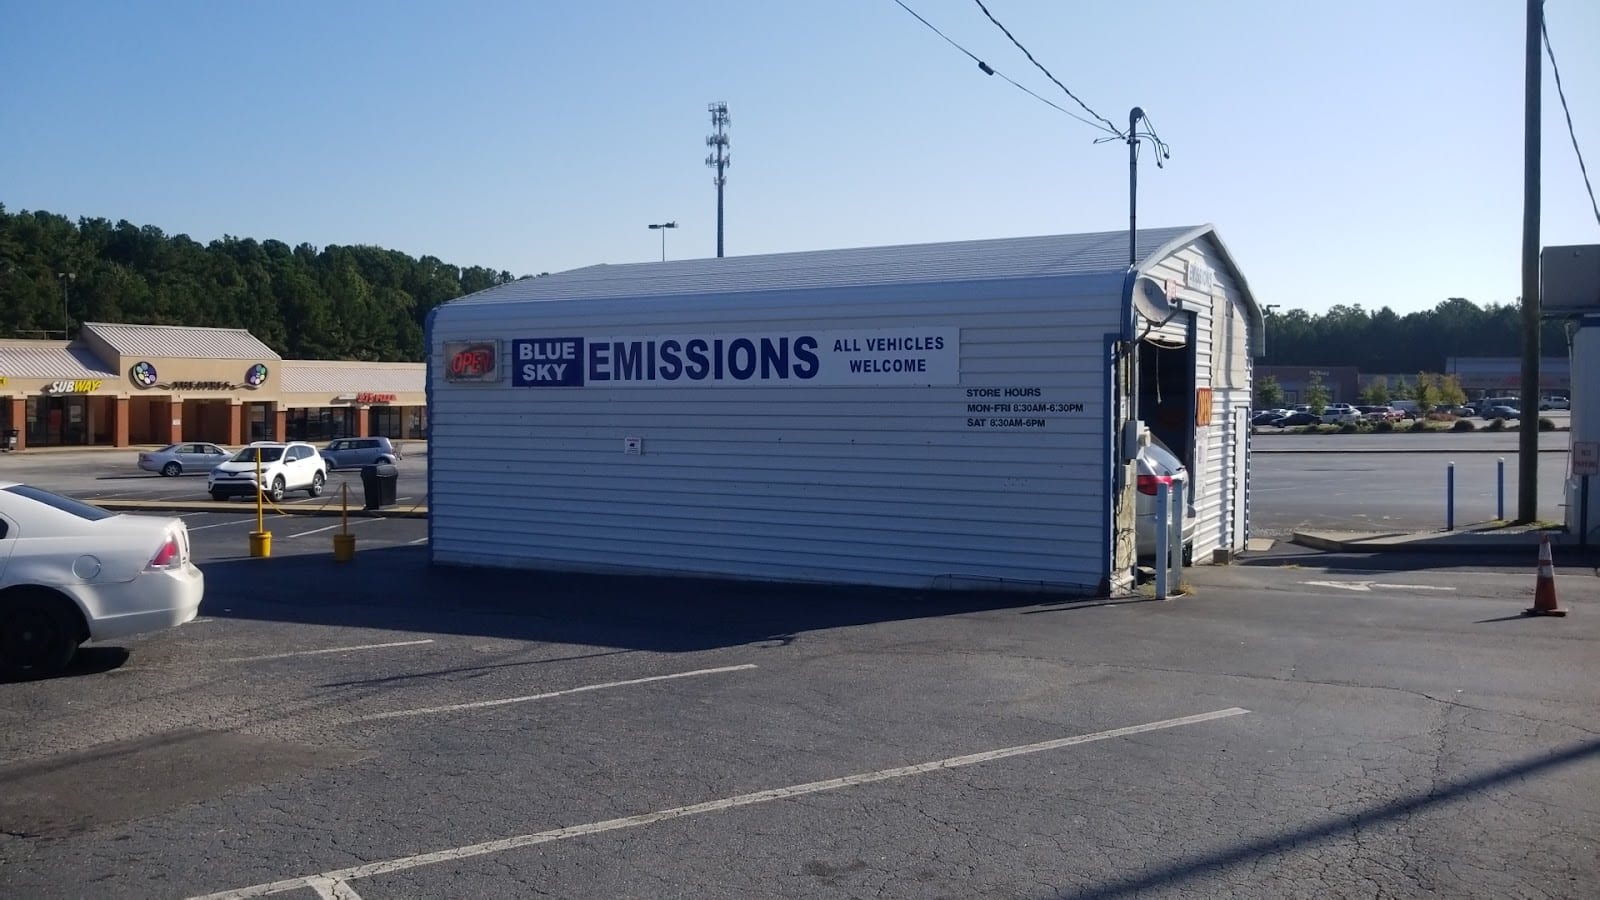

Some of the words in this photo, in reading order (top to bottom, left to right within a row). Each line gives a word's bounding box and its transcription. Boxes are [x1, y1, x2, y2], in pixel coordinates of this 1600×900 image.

[519, 342, 575, 360] BLUE
[833, 339, 861, 352] ALL
[866, 336, 944, 351] VEHICLES
[451, 351, 491, 374] OPEN
[589, 336, 820, 381] EMISSIONS
[849, 359, 926, 373] WELCOME
[522, 363, 568, 381] SKY
[49, 379, 102, 393] SUBWAY
[966, 388, 1001, 397] STORE
[1004, 388, 1041, 397] HOURS
[967, 404, 1011, 413] MON-FRI
[967, 418, 986, 427] SAT
